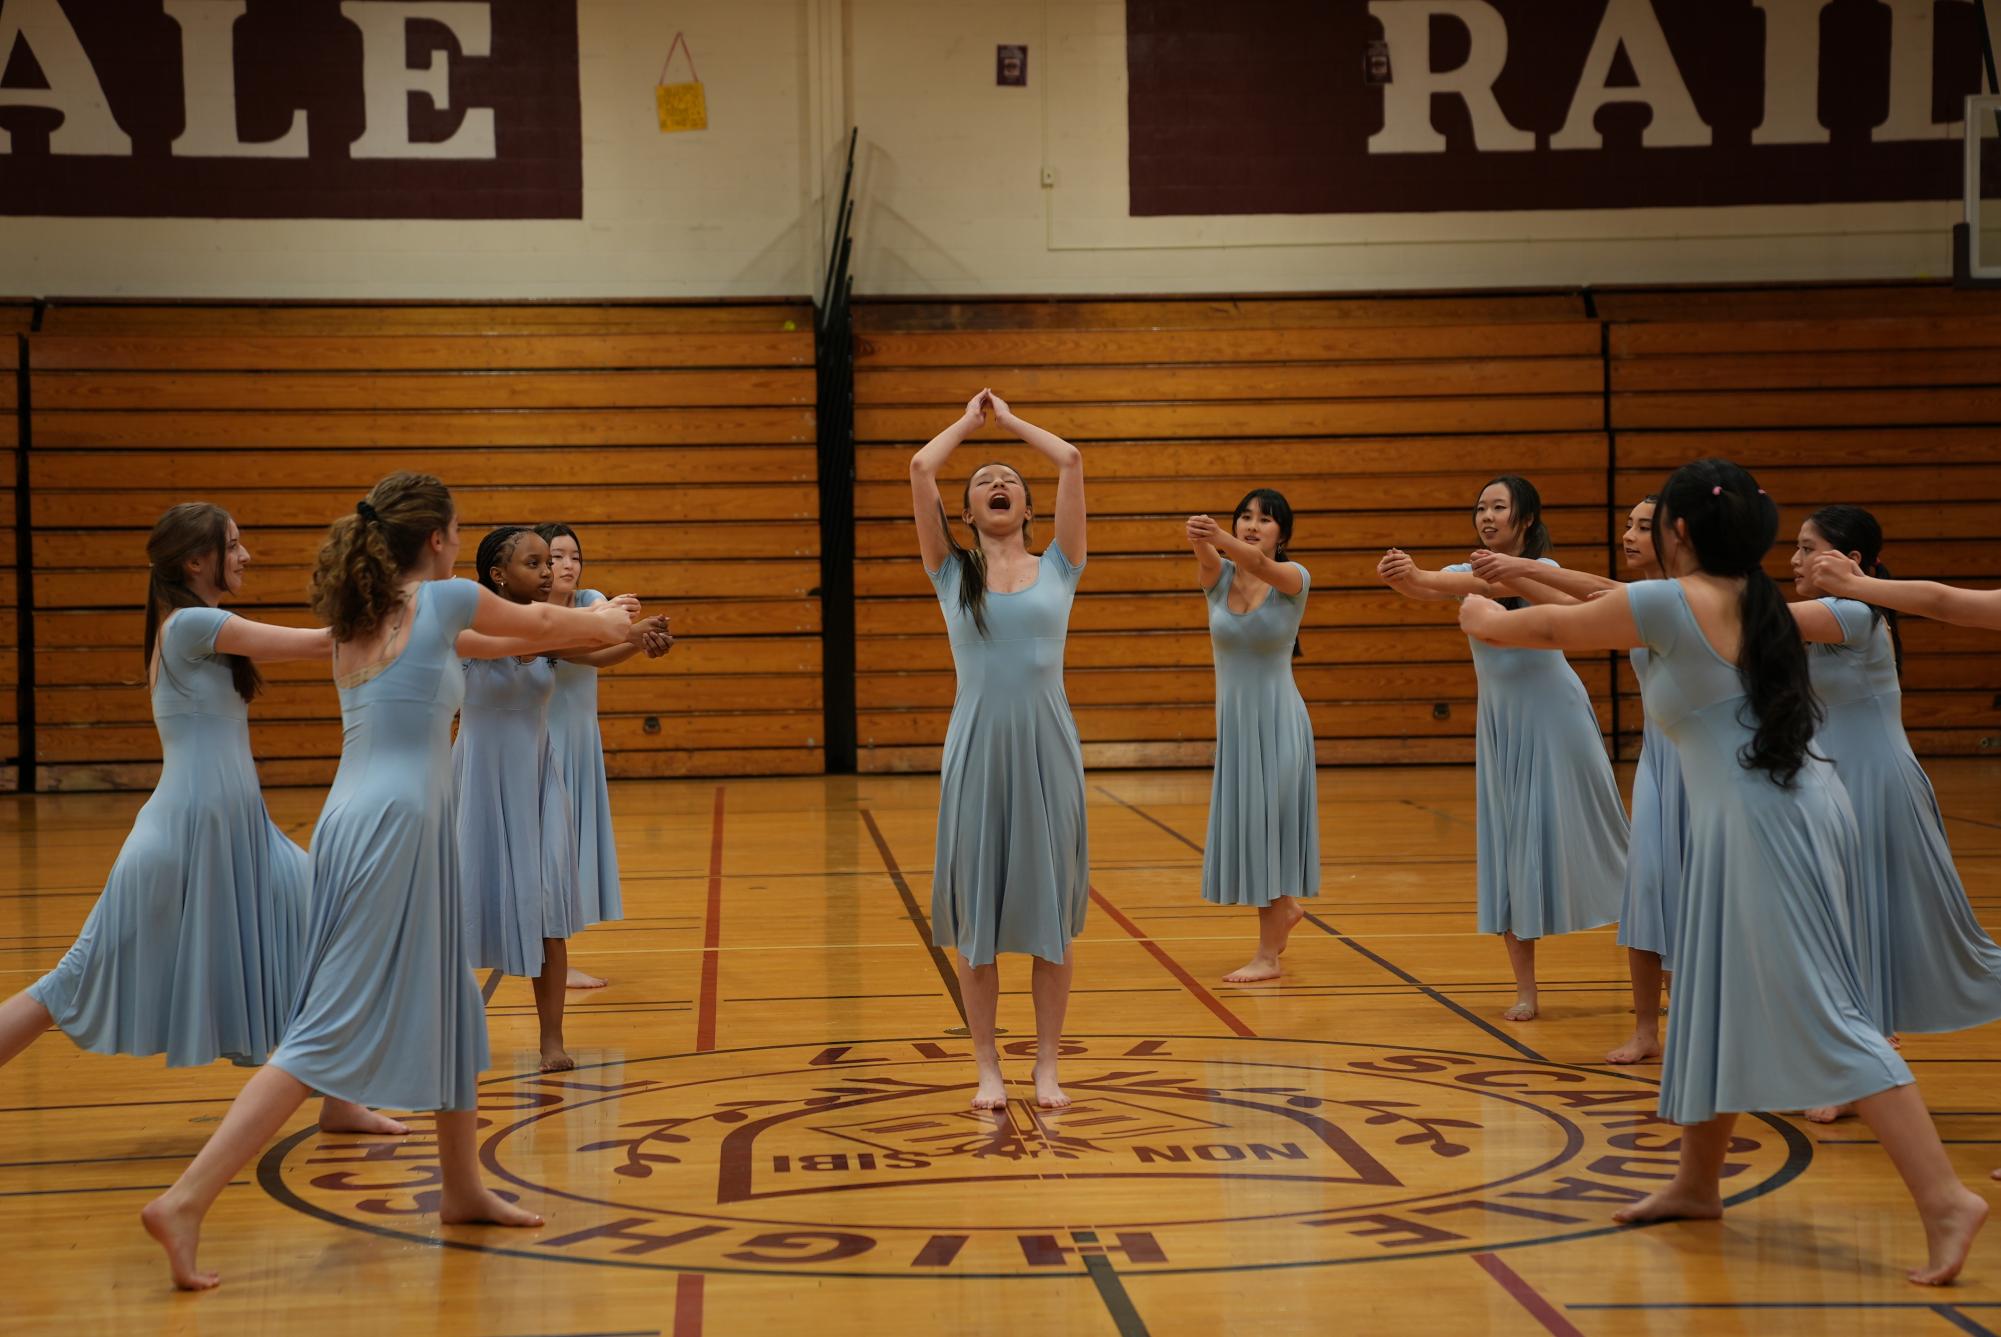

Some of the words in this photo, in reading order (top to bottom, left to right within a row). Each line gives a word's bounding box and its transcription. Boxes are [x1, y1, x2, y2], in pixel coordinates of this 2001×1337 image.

[808, 1040, 1173, 1066] 1917
[773, 1153, 932, 1173] SIBI
[1133, 1143, 1309, 1163] NON
[534, 1217, 1168, 1266] HIGH
